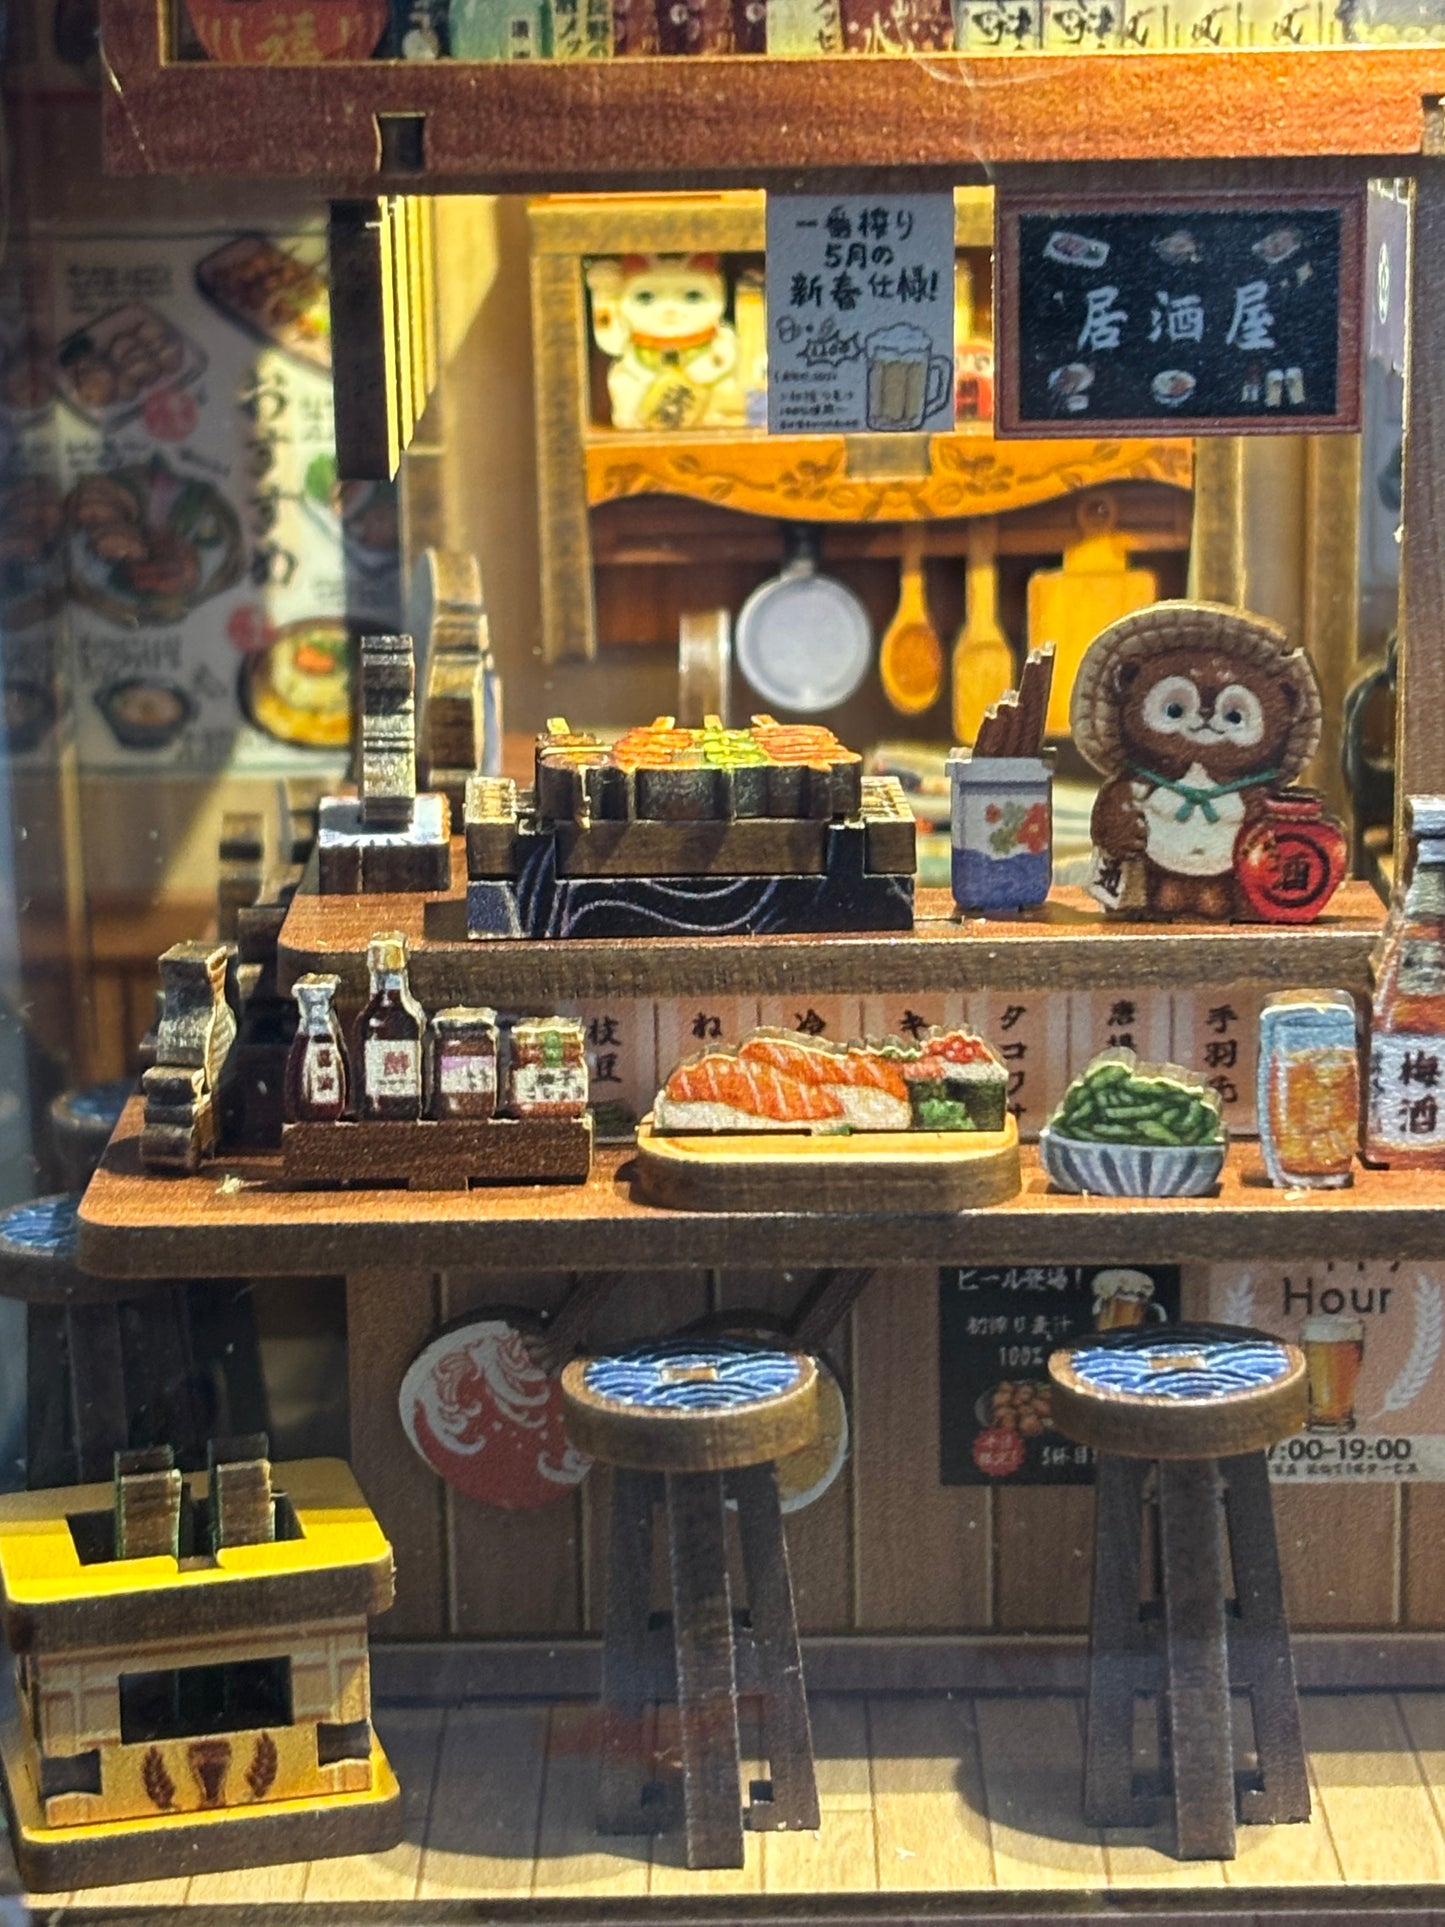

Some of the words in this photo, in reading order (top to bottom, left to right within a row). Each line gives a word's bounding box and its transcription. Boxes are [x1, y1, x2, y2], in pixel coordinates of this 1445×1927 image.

[824, 242, 895, 270] 5月の
[1076, 280, 1276, 351] 居酒屋
[588, 1015, 622, 1083] 枝豆
[1399, 1048, 1443, 1135] 梅酒
[1283, 1276, 1392, 1315] Hour
